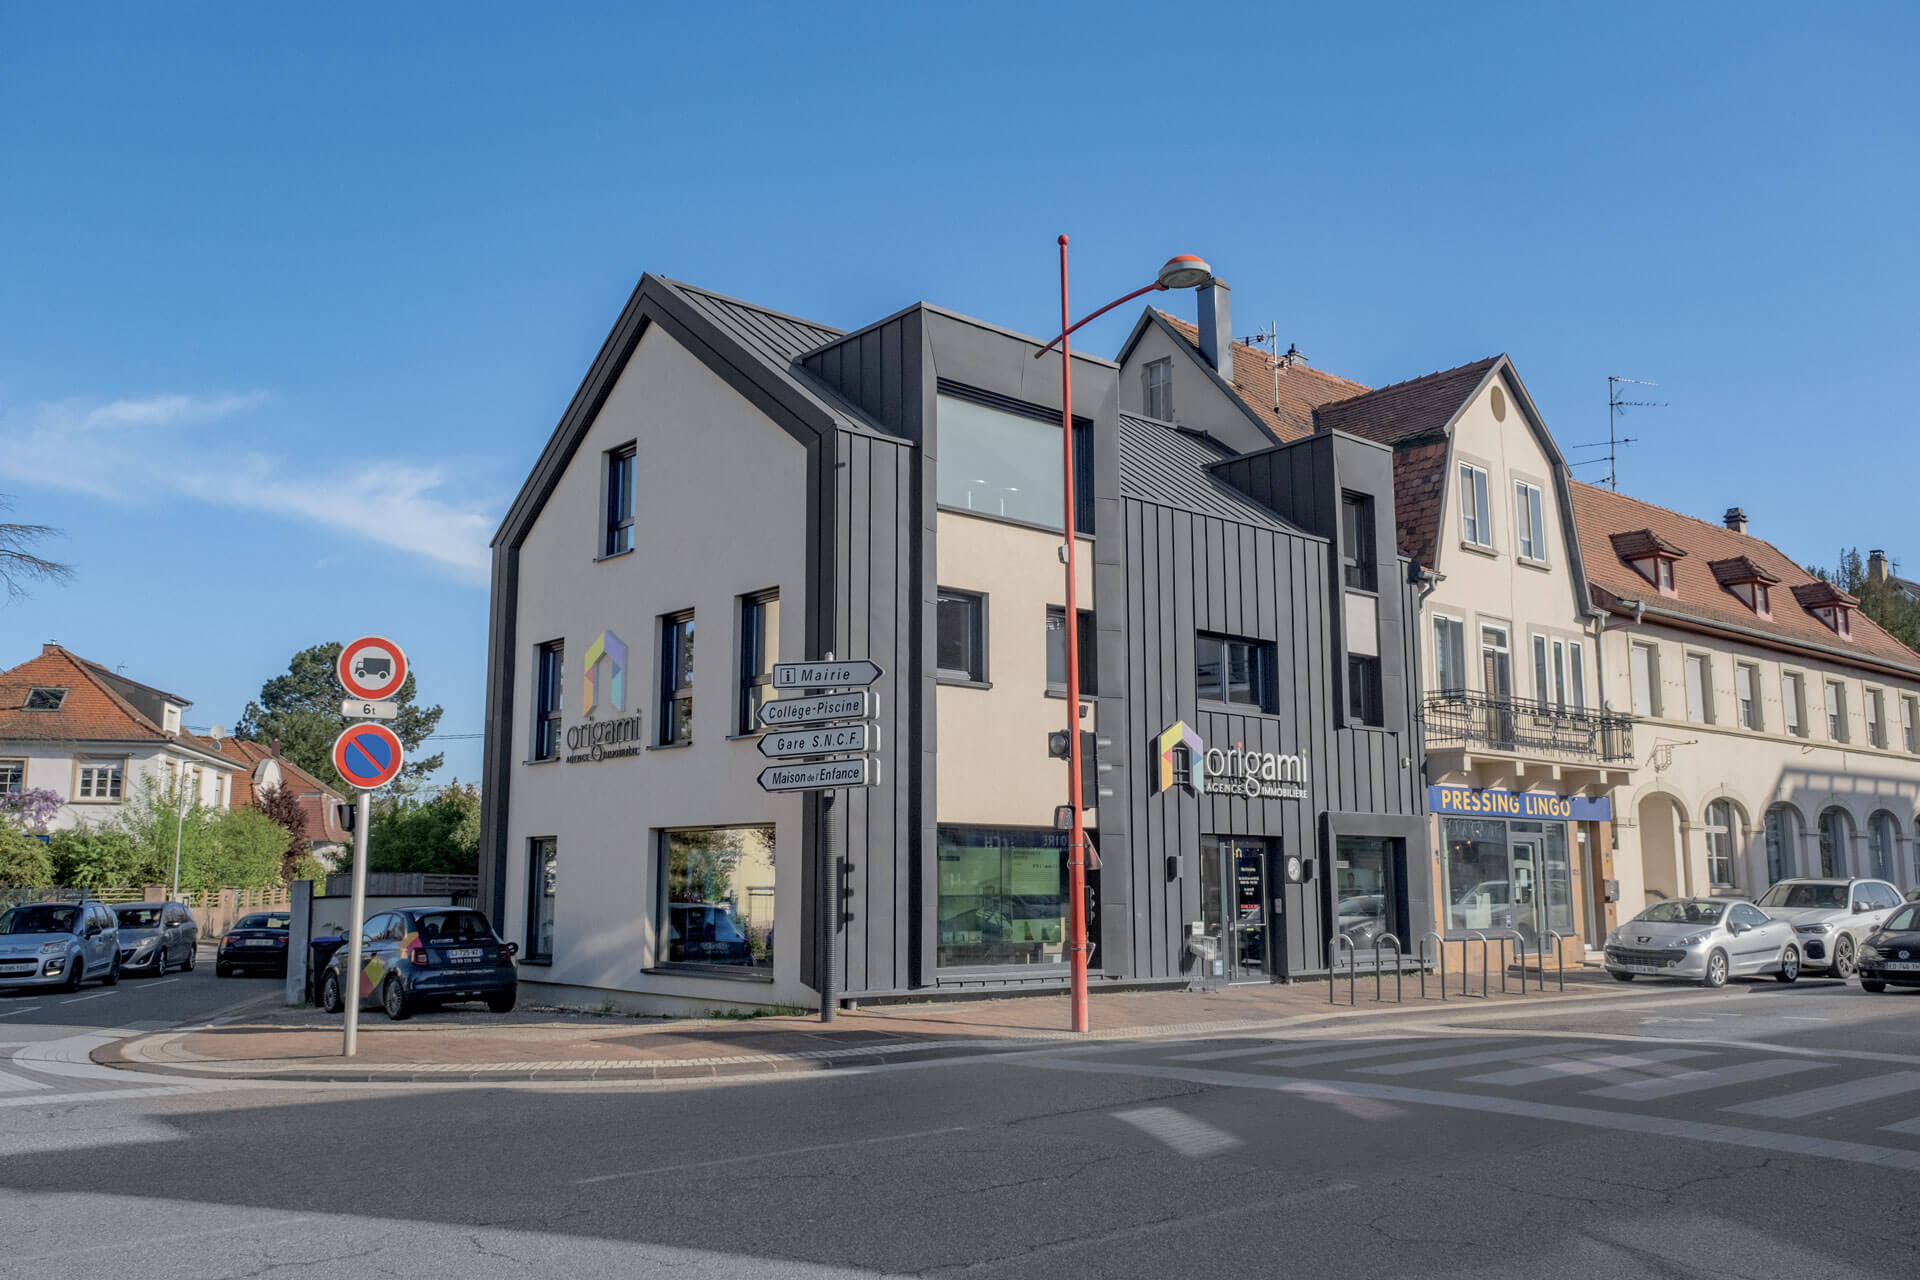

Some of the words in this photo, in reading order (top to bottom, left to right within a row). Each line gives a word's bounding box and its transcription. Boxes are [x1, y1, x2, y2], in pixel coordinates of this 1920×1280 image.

[801, 668, 850, 682] Mairie
[567, 709, 641, 761] origami
[777, 738, 805, 750] Gare
[812, 732, 859, 747] S.N.C.F.
[772, 771, 806, 784] Maison
[1206, 741, 1307, 797] origami
[1206, 783, 1243, 793] AGENCE
[1261, 784, 1308, 798] IMMOBILIÈRE
[1441, 789, 1520, 813] PRESSING
[1526, 796, 1571, 817] LINGO
